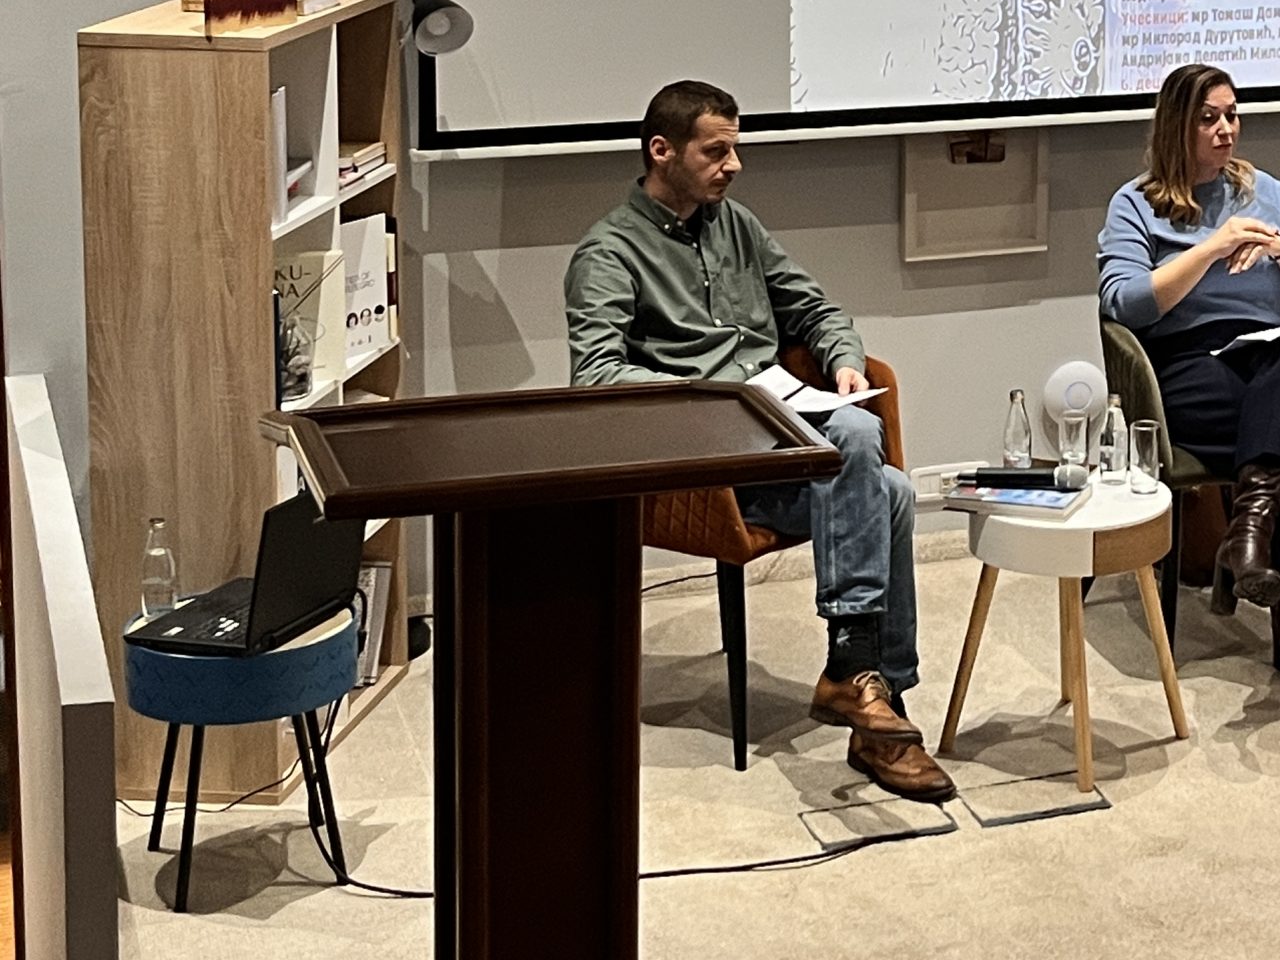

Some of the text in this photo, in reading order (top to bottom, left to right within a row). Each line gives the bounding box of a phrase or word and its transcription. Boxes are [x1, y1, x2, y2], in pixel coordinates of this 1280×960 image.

[1191, 10, 1209, 25] мр
[1211, 7, 1254, 21] Томаш
[1122, 34, 1139, 48] мр
[1142, 31, 1201, 46] Милорад
[1121, 50, 1191, 68] Андријана
[1194, 46, 1247, 63] Делетић
